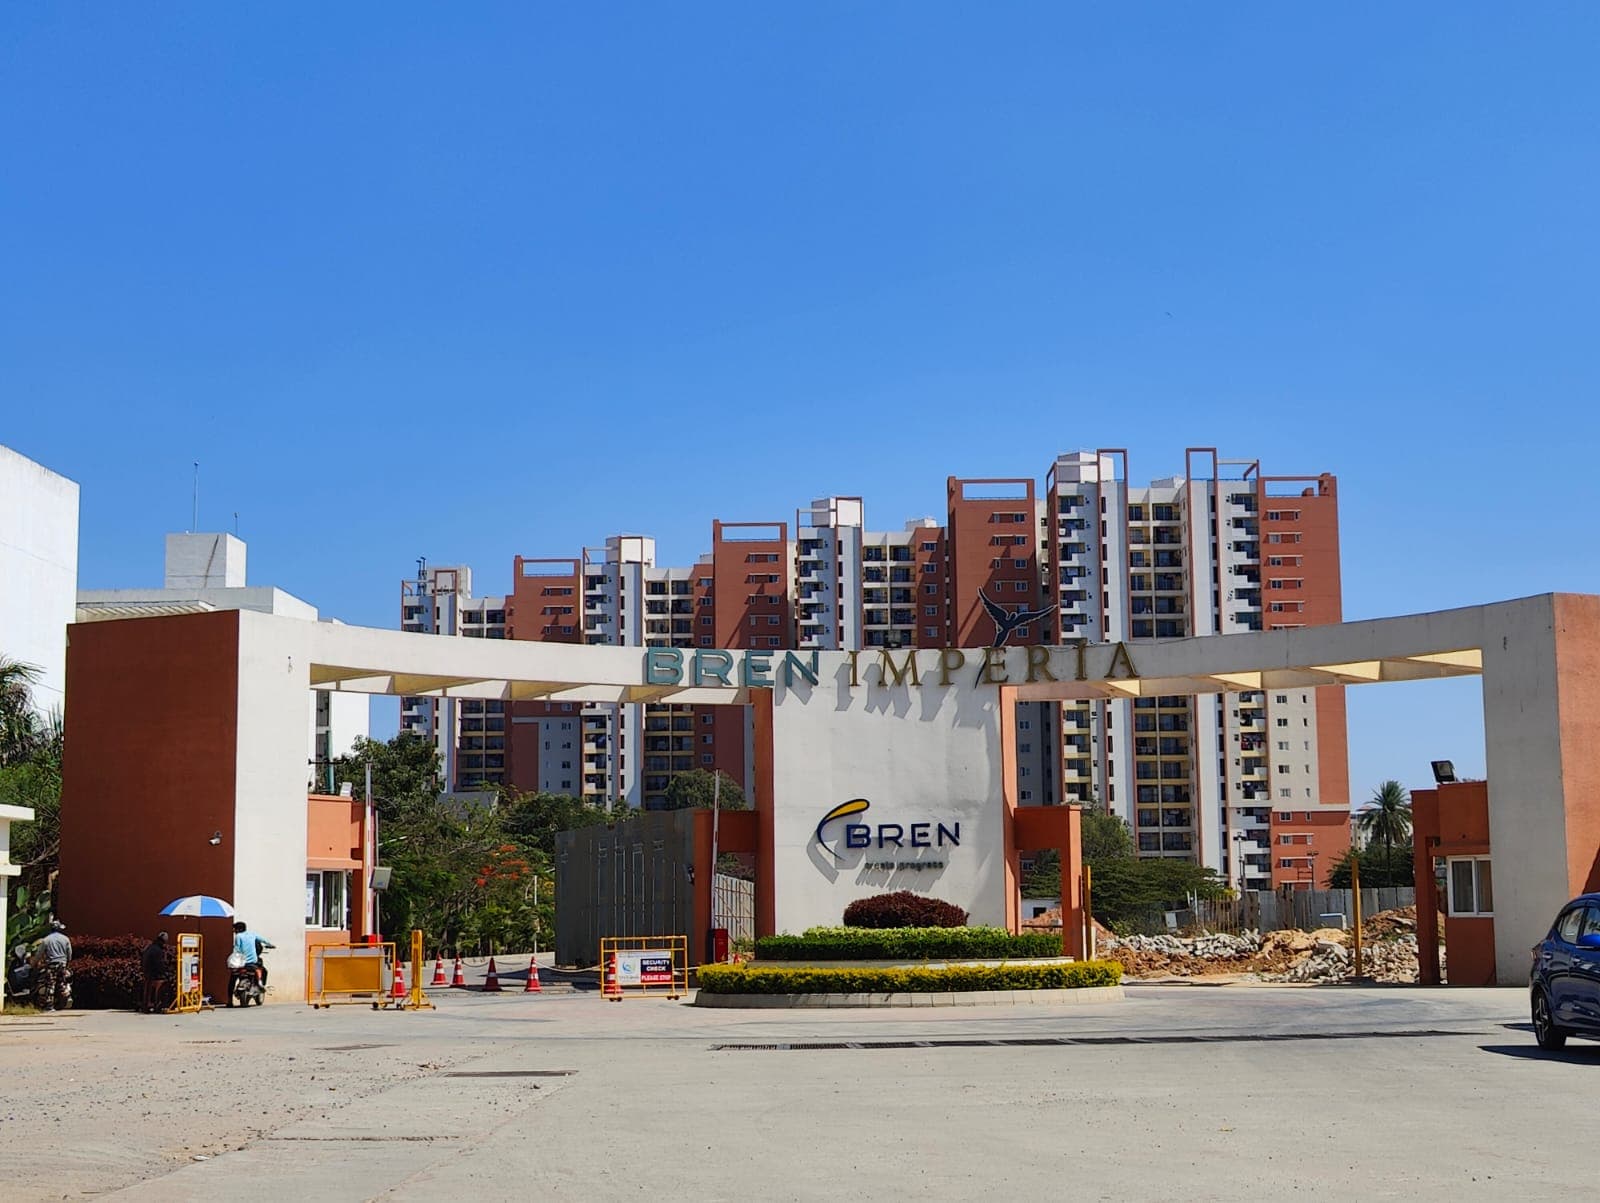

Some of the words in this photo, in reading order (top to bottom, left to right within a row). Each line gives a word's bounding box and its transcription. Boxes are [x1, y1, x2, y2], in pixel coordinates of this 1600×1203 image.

[645, 647, 820, 687] BREN
[848, 642, 1140, 687] IMPERIA
[846, 822, 960, 849] BREN
